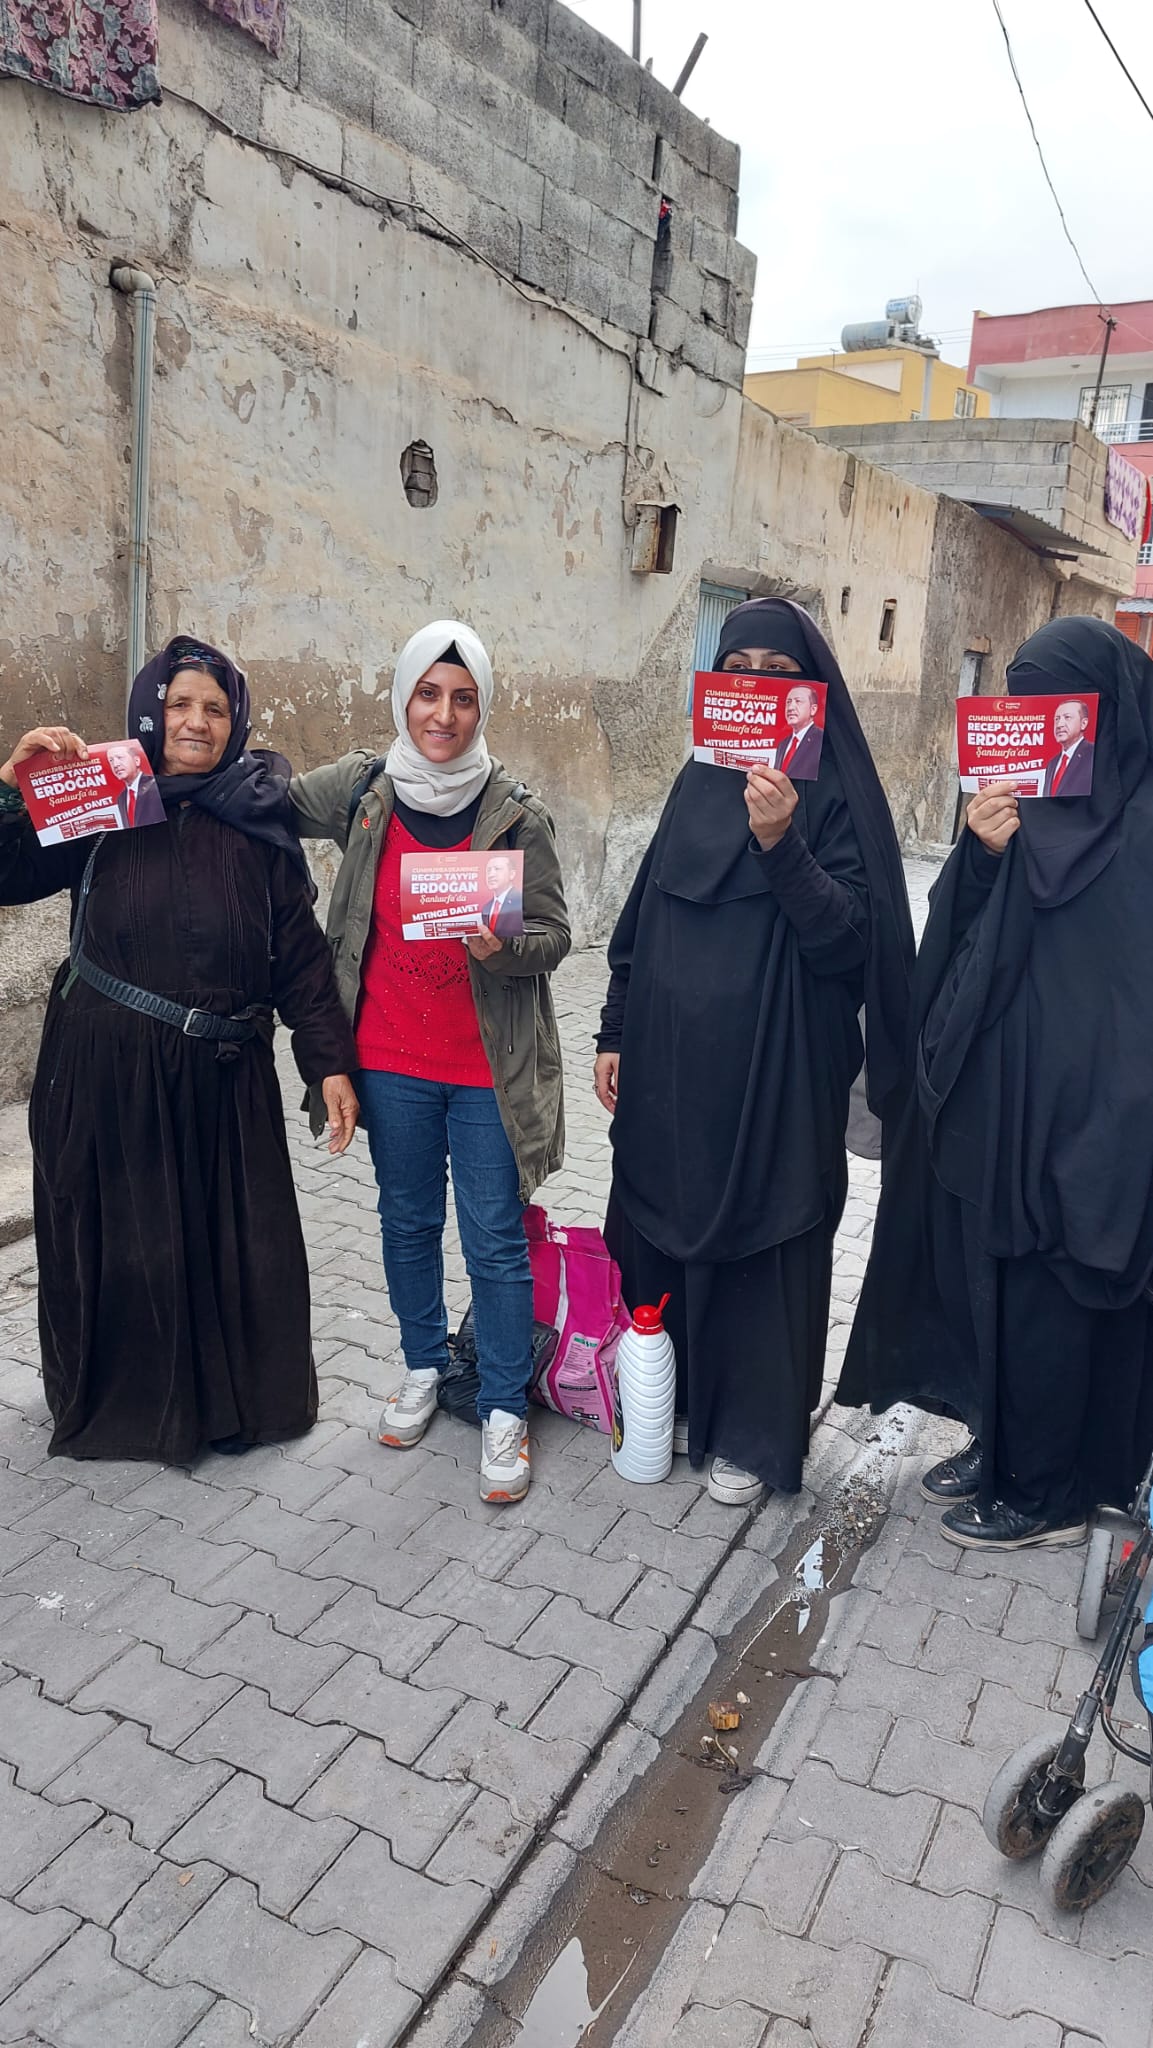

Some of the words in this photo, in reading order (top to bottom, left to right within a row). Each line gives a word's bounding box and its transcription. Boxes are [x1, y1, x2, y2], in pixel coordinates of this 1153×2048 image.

[704, 697, 738, 708] RECEP
[741, 700, 777, 711] TAYYİP
[703, 707, 776, 725] ERDOĞAN
[967, 722, 1000, 732] RECEP
[1004, 722, 1045, 732] TAYYİP
[741, 738, 775, 748] DAVET
[967, 731, 1044, 746] ERDOĞAN
[1008, 759, 1044, 772] DAVET
[31, 773, 65, 787] RECEP
[67, 764, 103, 779] TAYYİP
[34, 774, 107, 799] ERDOĞAN
[84, 796, 114, 814] DAVET
[411, 873, 441, 881] RECEP
[445, 872, 478, 881] TAYYİP
[411, 881, 478, 894] ERDOĞAN
[450, 904, 479, 915] DAVET
